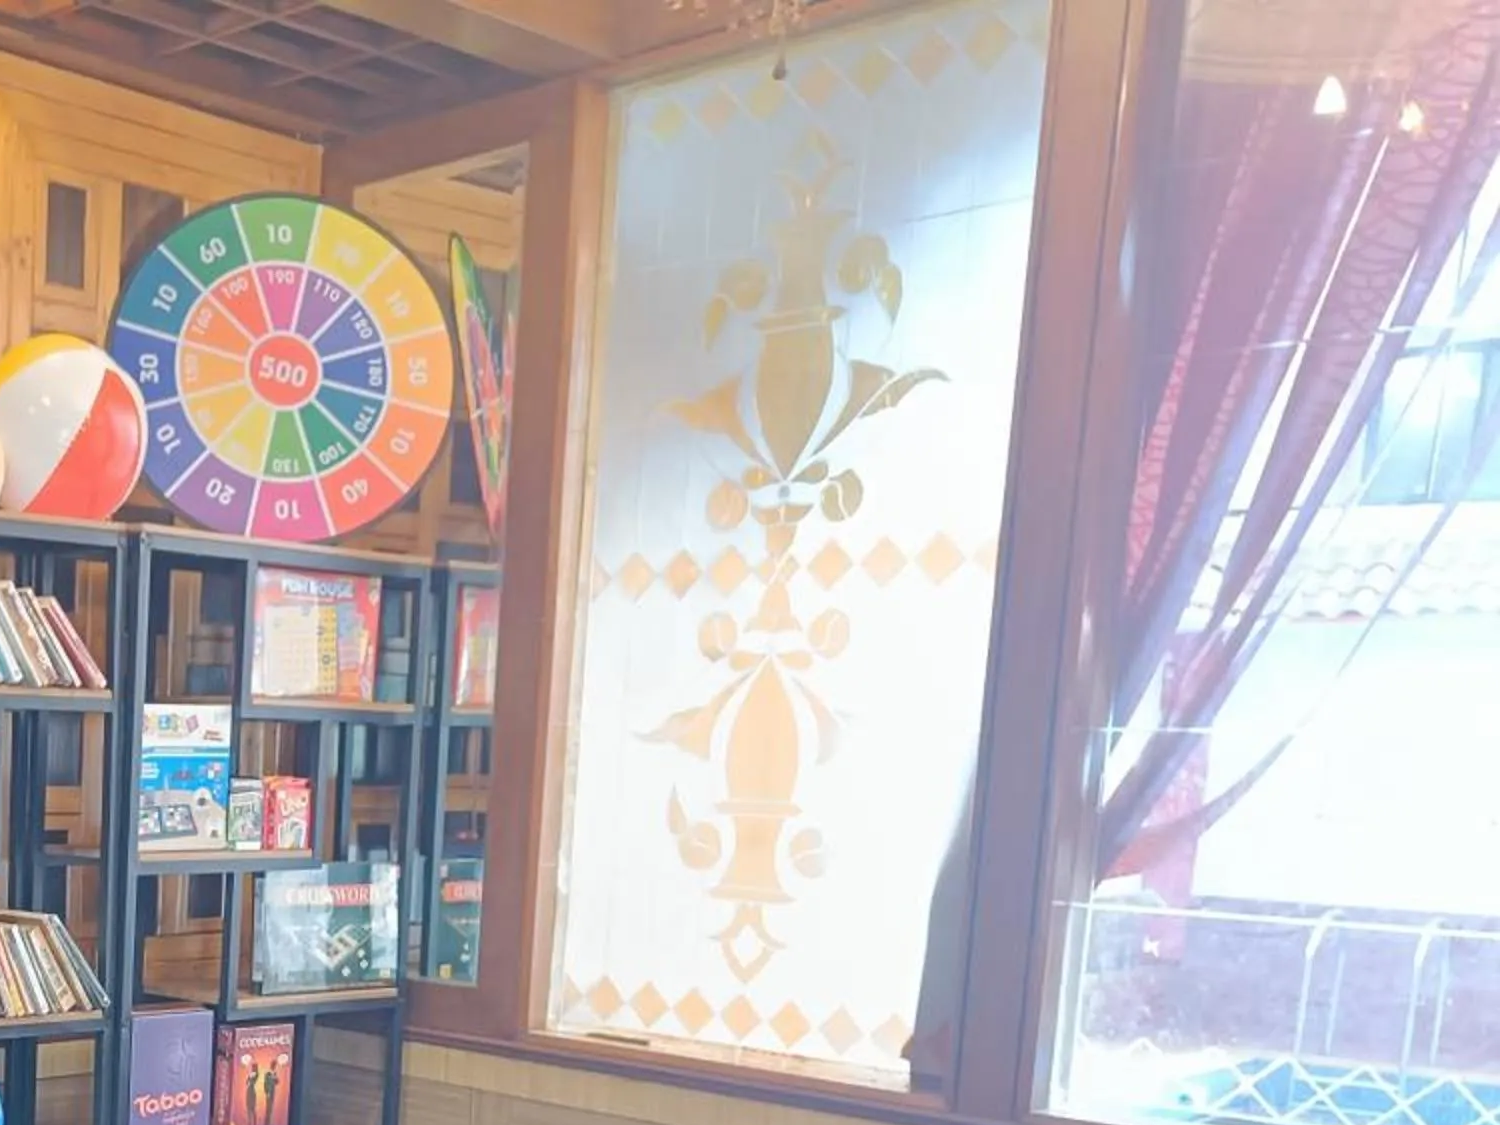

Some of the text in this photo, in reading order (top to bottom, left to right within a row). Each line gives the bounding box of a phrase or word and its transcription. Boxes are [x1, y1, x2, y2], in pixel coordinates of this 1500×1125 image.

[266, 223, 293, 244] 10
[200, 237, 227, 264] 60
[152, 284, 178, 312] 10
[313, 277, 341, 303] 110
[139, 353, 159, 384] 30
[259, 354, 308, 388] 500
[408, 356, 429, 386] 50
[156, 423, 181, 455] 10
[389, 428, 416, 455] 10
[205, 478, 236, 505] 20
[341, 478, 369, 504] 40
[274, 498, 301, 520] 10
[133, 1089, 202, 1118] Taboo
